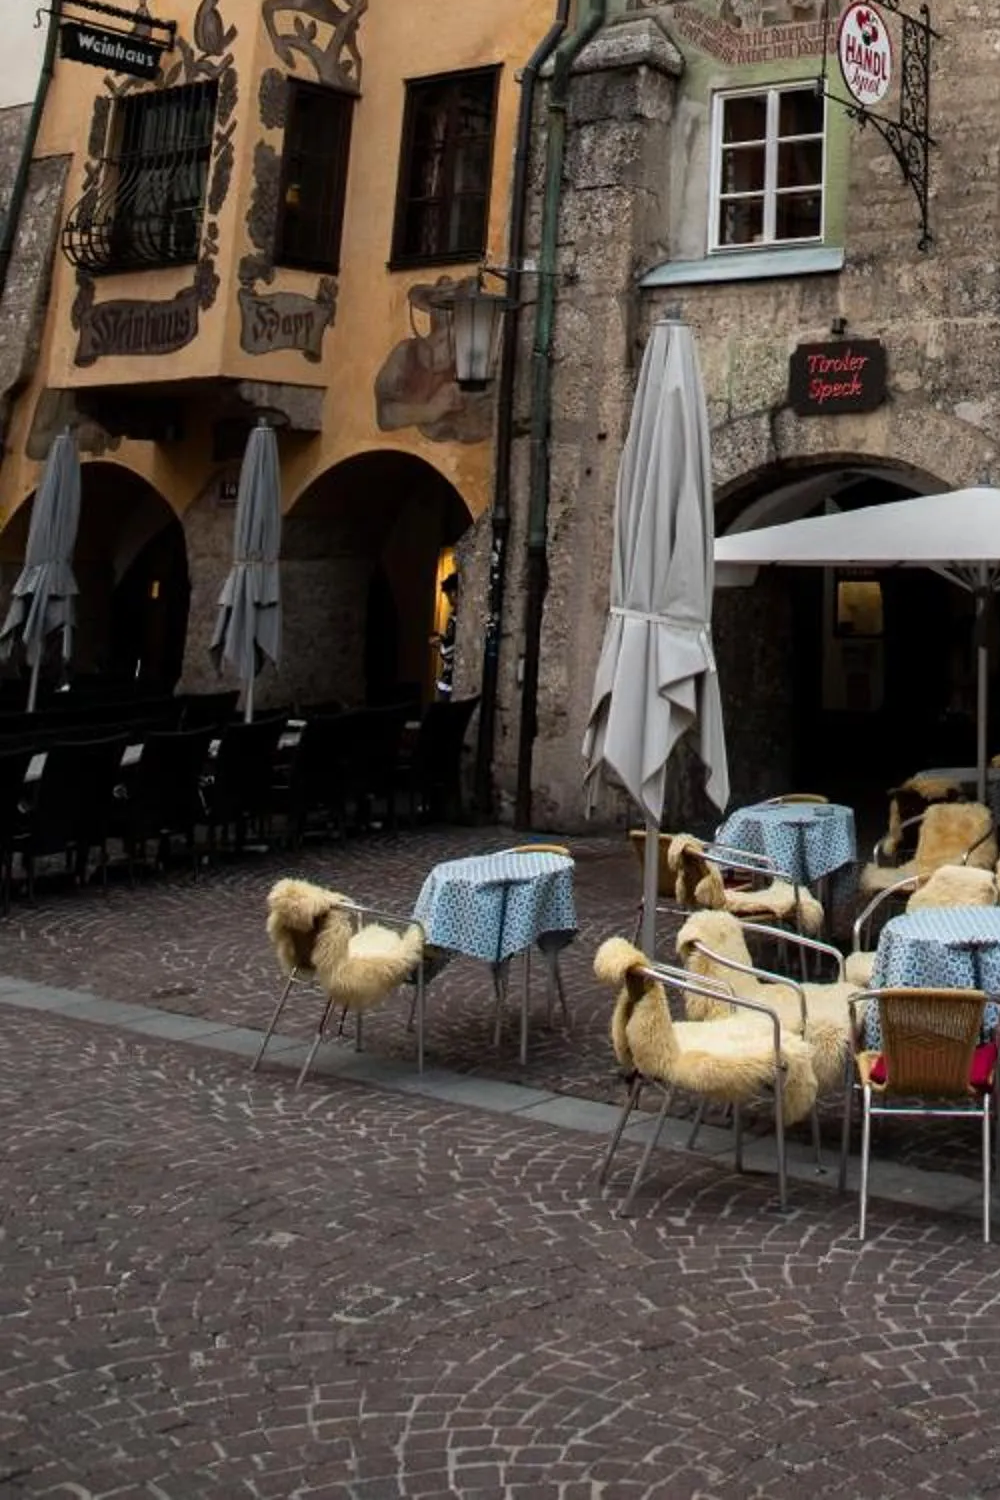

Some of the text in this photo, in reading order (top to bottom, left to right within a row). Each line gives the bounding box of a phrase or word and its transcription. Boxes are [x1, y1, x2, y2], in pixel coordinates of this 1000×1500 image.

[77, 31, 155, 67] Weinhaus
[845, 33, 888, 81] HANDL
[808, 349, 869, 373] Tiroler
[808, 373, 863, 405] Speck
